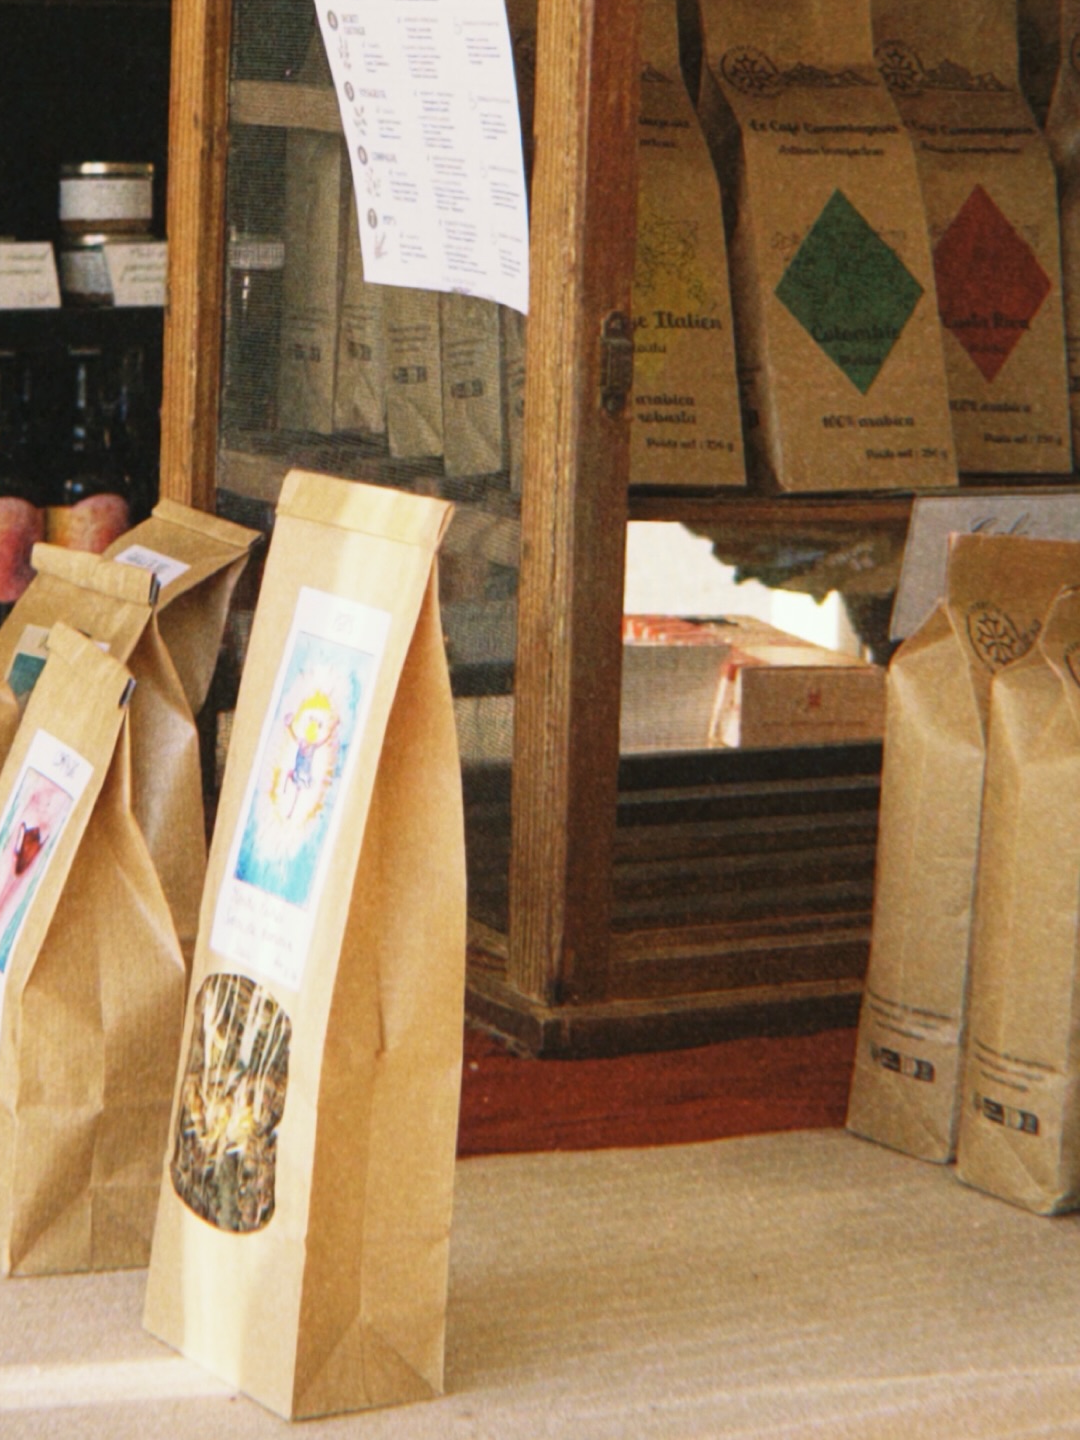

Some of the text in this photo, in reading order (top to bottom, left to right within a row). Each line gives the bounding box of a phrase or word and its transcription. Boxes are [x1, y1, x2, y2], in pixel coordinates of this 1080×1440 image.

[653, 310, 723, 331] Italien
[635, 393, 695, 407] arabica
[636, 410, 697, 425] robusta
[858, 414, 915, 428] arabica
